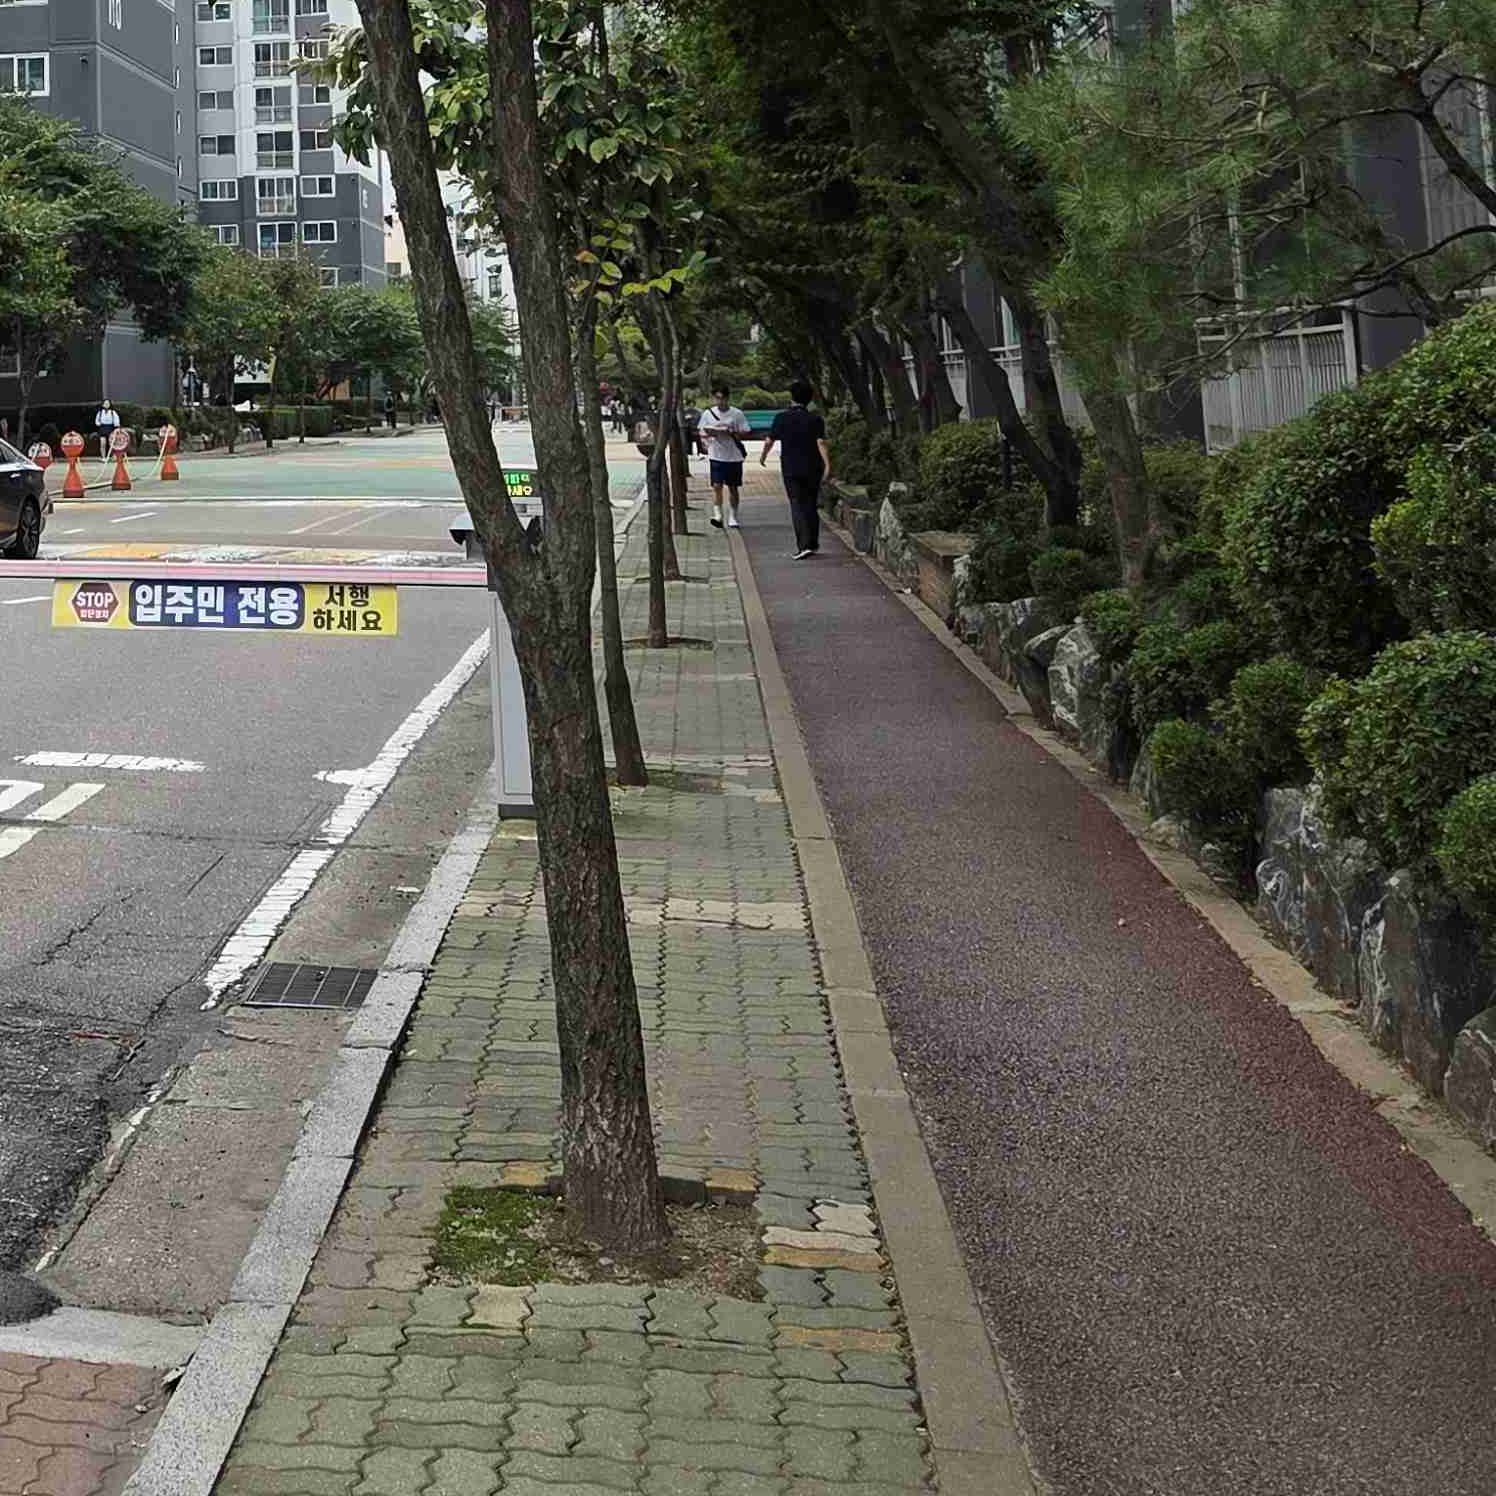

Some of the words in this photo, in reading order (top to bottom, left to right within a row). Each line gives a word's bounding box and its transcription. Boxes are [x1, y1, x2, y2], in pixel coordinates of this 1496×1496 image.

[75, 591, 114, 608] STOP
[135, 584, 224, 624] 입주민
[237, 585, 300, 626] 전용
[326, 584, 370, 607] 서행
[312, 610, 382, 632] 하세요
